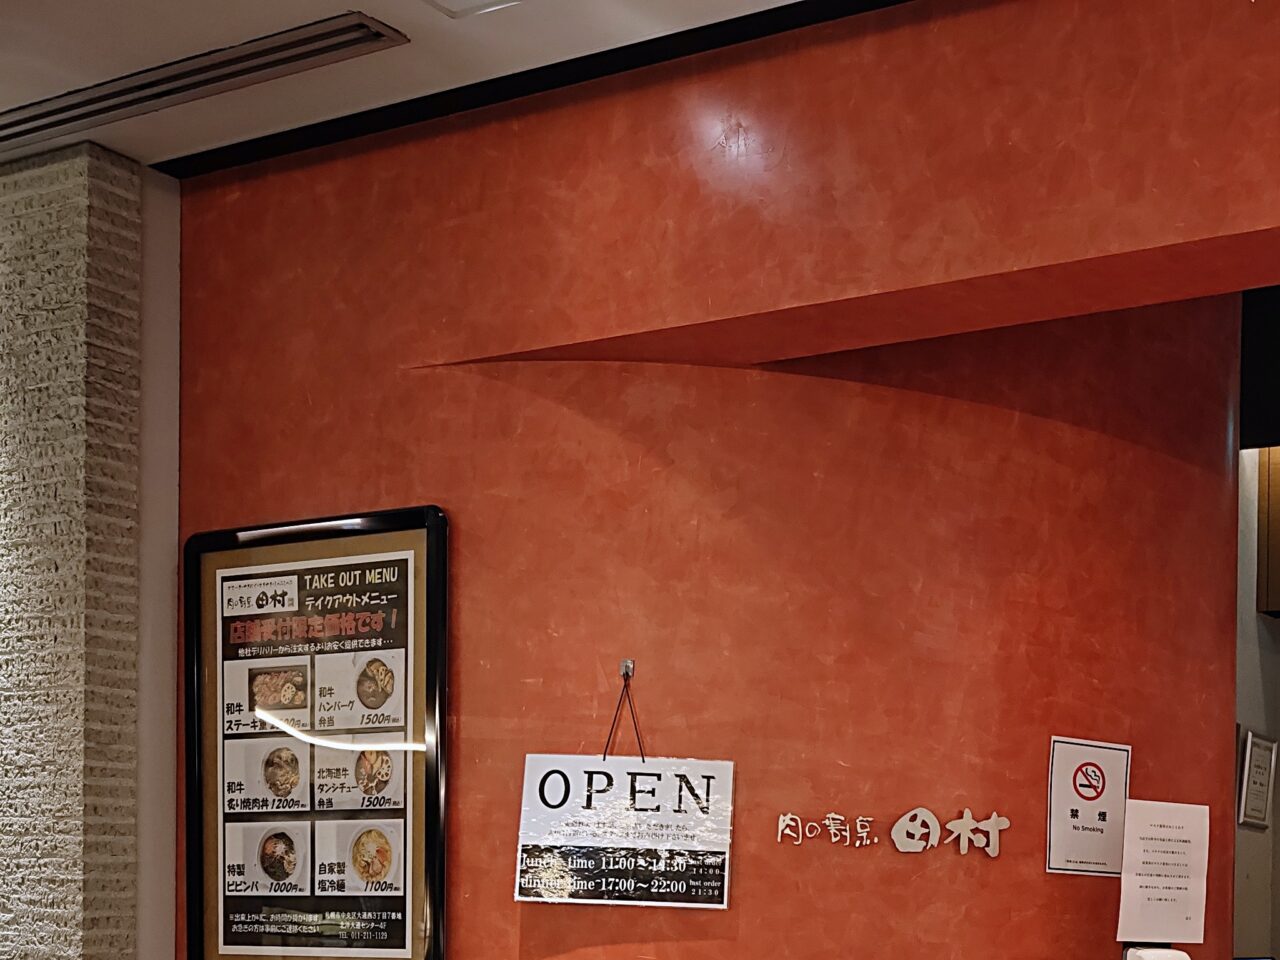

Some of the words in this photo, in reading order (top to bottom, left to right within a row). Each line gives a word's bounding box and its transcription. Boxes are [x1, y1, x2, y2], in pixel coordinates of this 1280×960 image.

[304, 573, 335, 590] TAKE
[339, 570, 361, 586] OUT
[365, 567, 398, 583] MENU
[305, 592, 398, 611] テイクアウトメニュー
[319, 686, 335, 698] 和牛
[225, 702, 244, 715] 和牛
[318, 700, 354, 712] ハンバーグ
[318, 716, 335, 727] 弁当
[360, 713, 392, 726] 1500円
[317, 768, 349, 780] 北海道牛
[226, 781, 245, 793] 和牛
[317, 782, 359, 794] タンシチュー
[538, 769, 715, 814] OPEN
[271, 797, 300, 810] 1200円
[317, 797, 334, 809] 弁当
[360, 796, 392, 808] 1500円
[891, 806, 1010, 858] 田村
[1081, 825, 1104, 834] Smoking
[227, 863, 245, 876] 特製
[318, 862, 346, 875] 自家製
[568, 856, 596, 870] time
[268, 881, 299, 893] 1000円
[364, 880, 393, 892] 1100円
